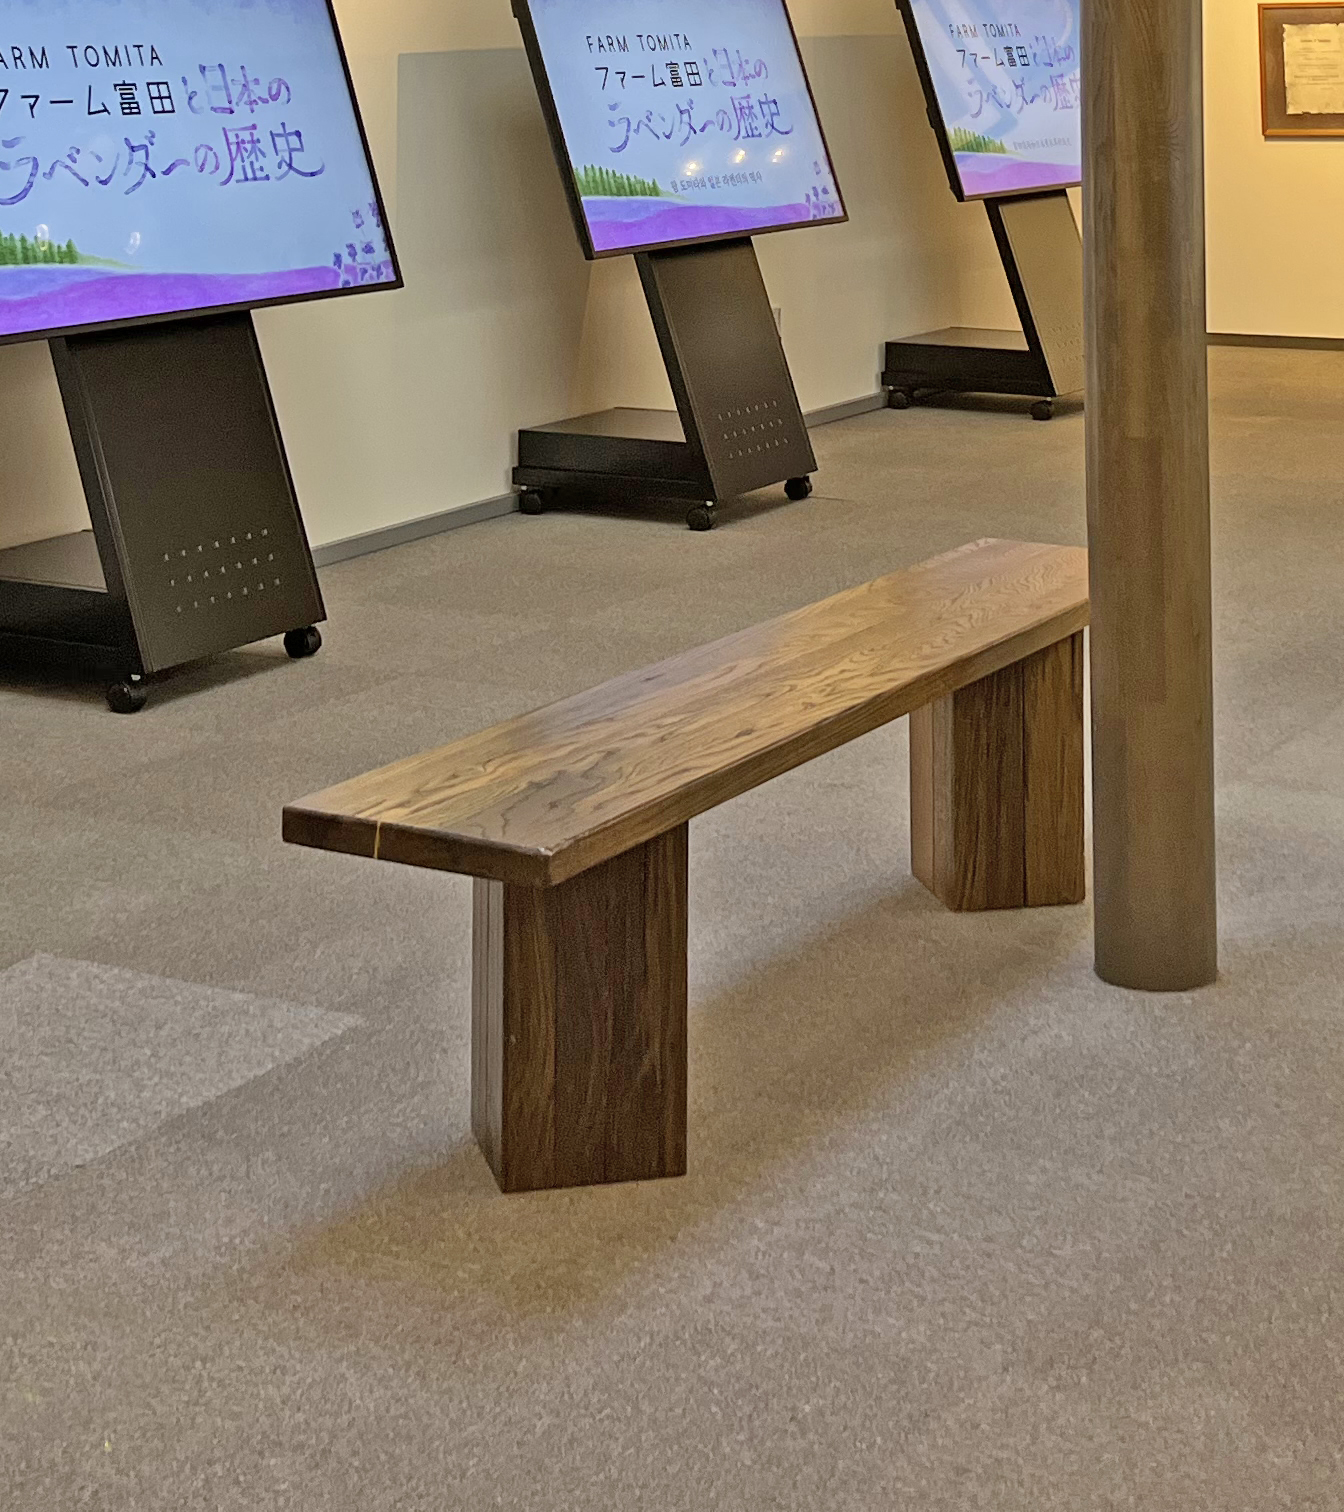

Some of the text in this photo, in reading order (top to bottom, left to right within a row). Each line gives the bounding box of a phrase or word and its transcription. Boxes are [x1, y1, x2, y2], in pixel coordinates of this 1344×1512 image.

[948, 23, 1022, 37] FARM TOMITA
[586, 33, 693, 54] FARM TOMITA
[66, 44, 164, 68] TOMITA
[608, 93, 794, 153] ラベンダーの歴史
